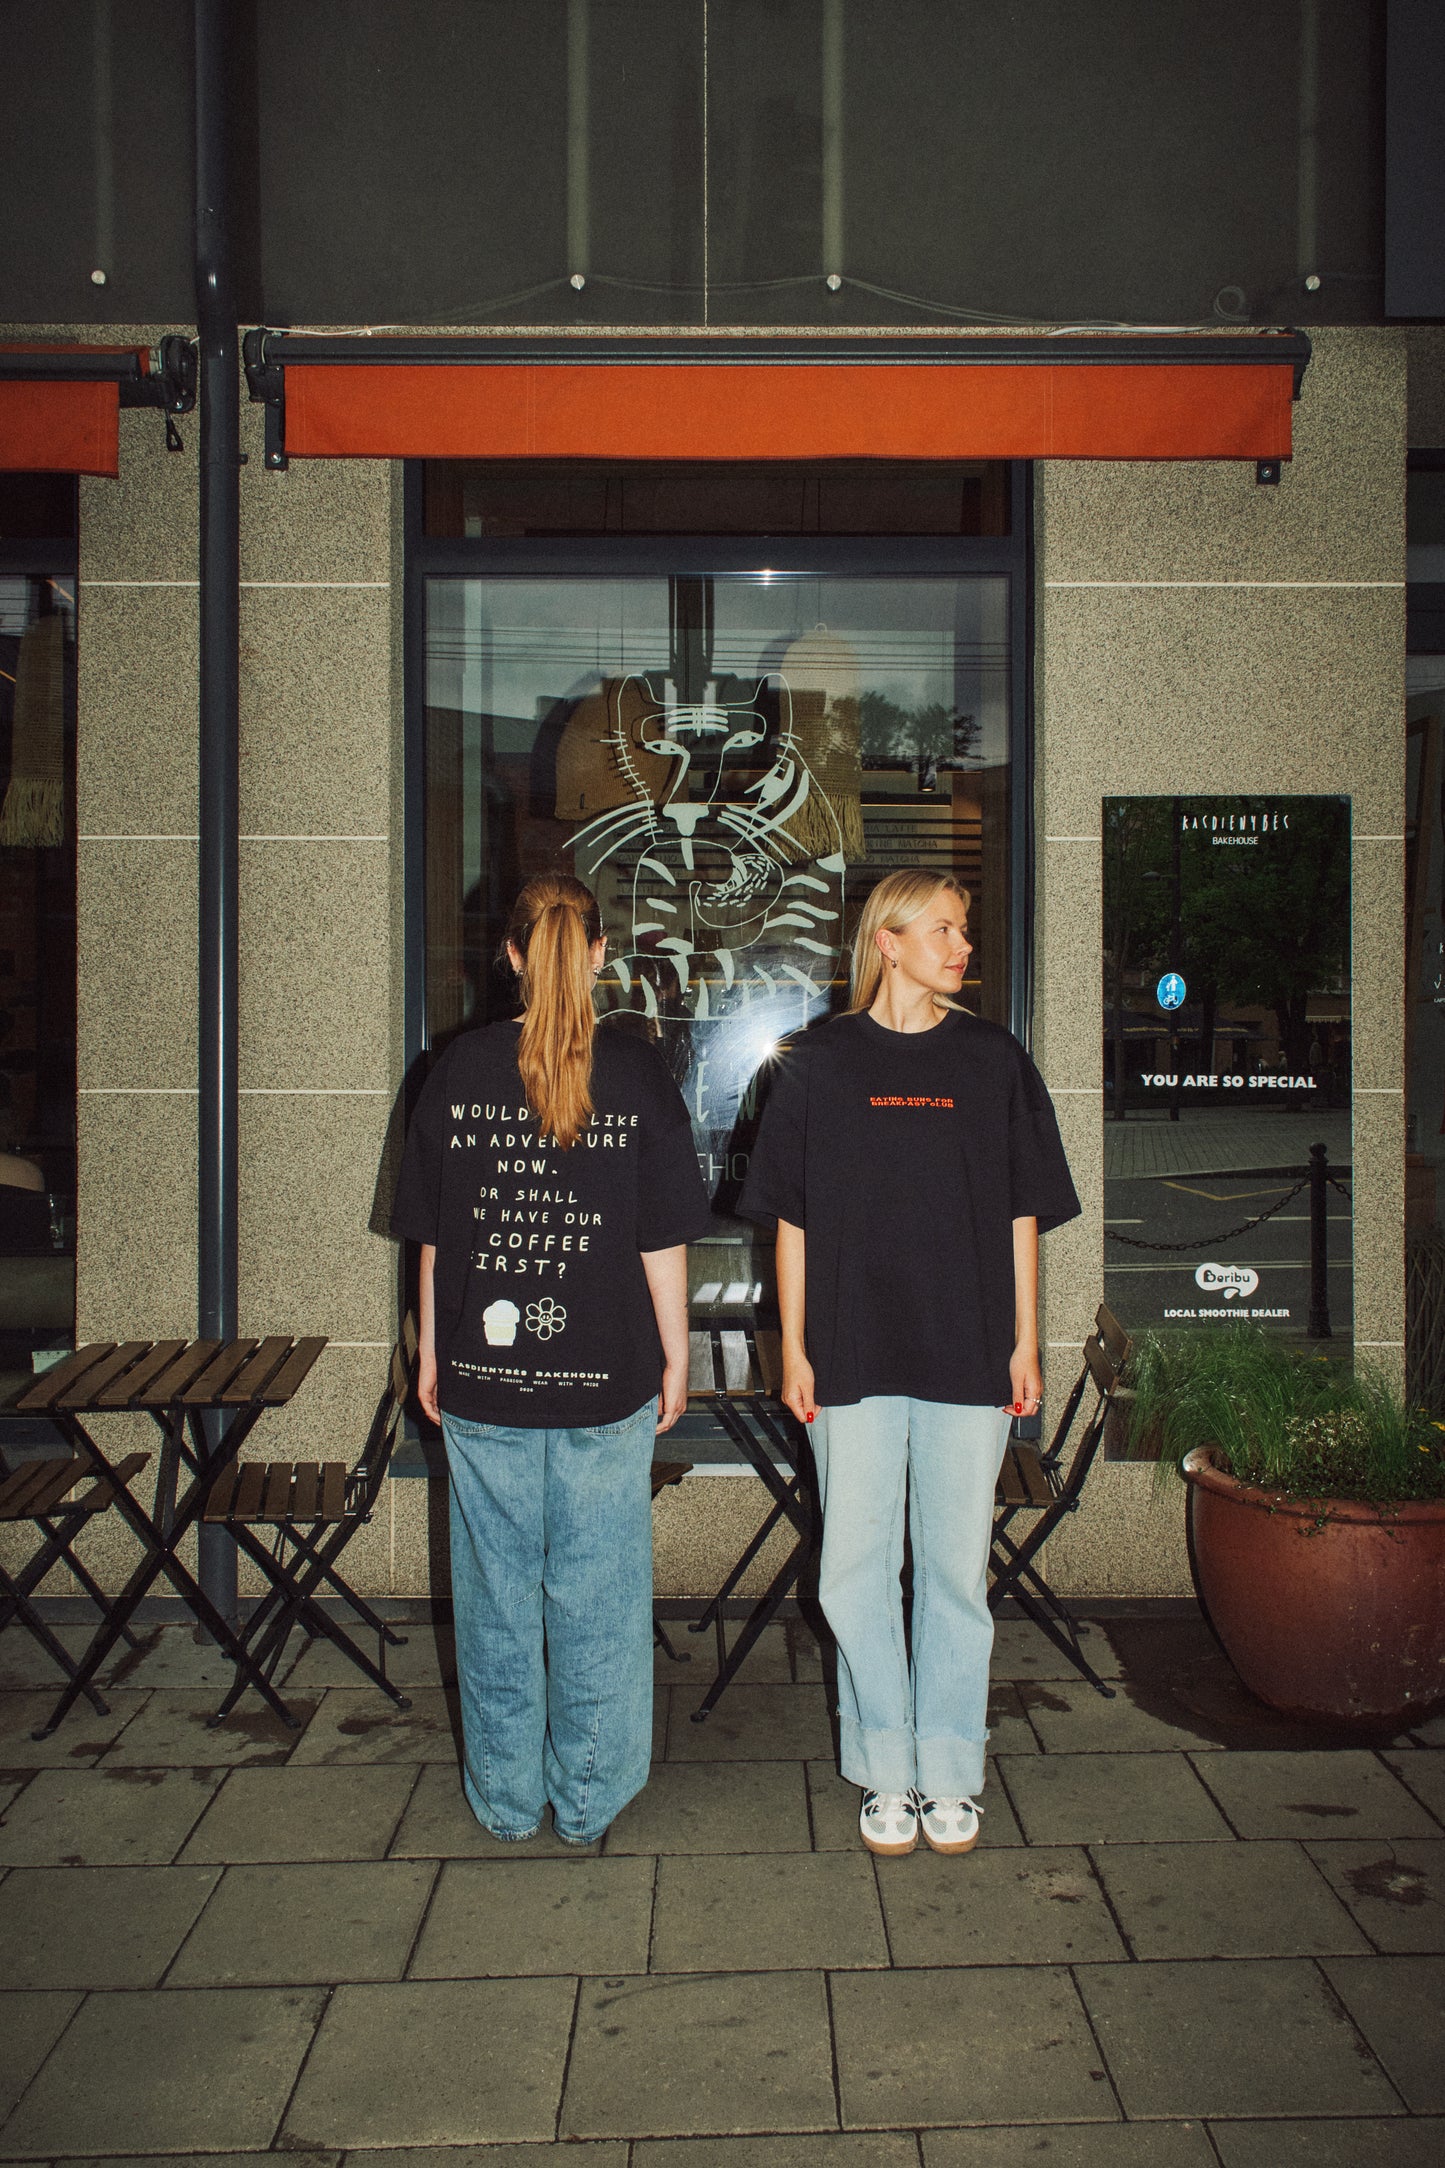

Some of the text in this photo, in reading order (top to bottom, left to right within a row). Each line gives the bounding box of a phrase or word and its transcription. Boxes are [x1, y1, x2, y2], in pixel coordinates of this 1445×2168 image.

[1182, 811, 1289, 832] KASDIENYBĖS
[1212, 836, 1258, 845] BAKEHOUSE
[1141, 1074, 1317, 1089] YOU ARE SO SPECIAL
[451, 1104, 638, 1127] WOULD LIKE
[450, 1134, 476, 1149] AN
[497, 1159, 558, 1175] NOW.
[480, 1187, 578, 1204] OR SHALL
[473, 1207, 602, 1226] WE HAVE OUR
[489, 1233, 590, 1251] COFFEE
[471, 1251, 566, 1279] IRST?
[1203, 1269, 1250, 1283] Beribu
[1164, 1309, 1290, 1318] LOCAL SMOOTHIE DEALER
[535, 1371, 609, 1380] BAKEHOUSE
